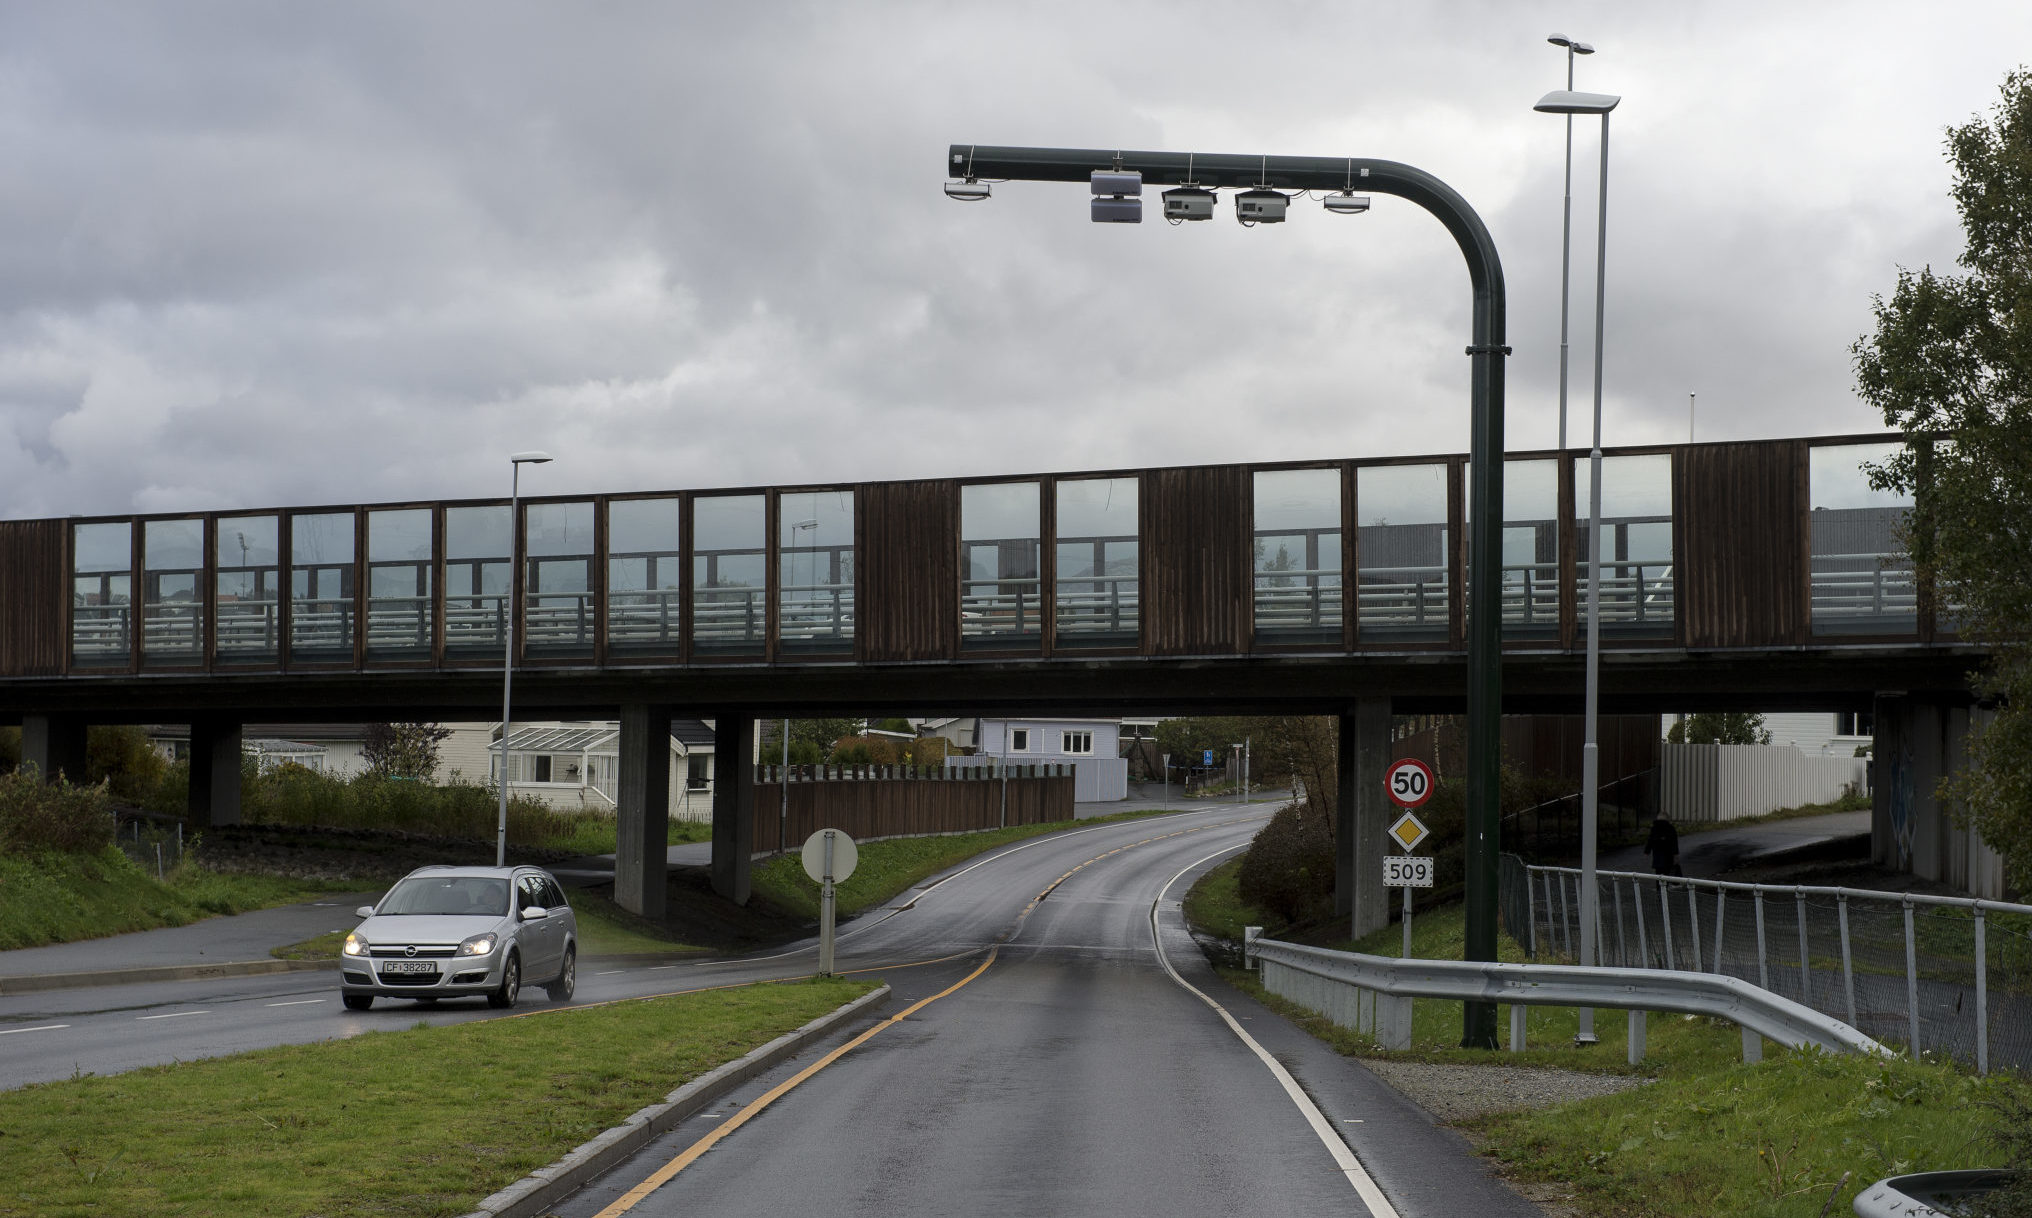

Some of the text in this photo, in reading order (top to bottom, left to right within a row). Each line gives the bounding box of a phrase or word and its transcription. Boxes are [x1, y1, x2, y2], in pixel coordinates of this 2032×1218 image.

[1393, 771, 1426, 795] 50
[1390, 863, 1427, 880] 509
[386, 963, 432, 971] CF 38287
